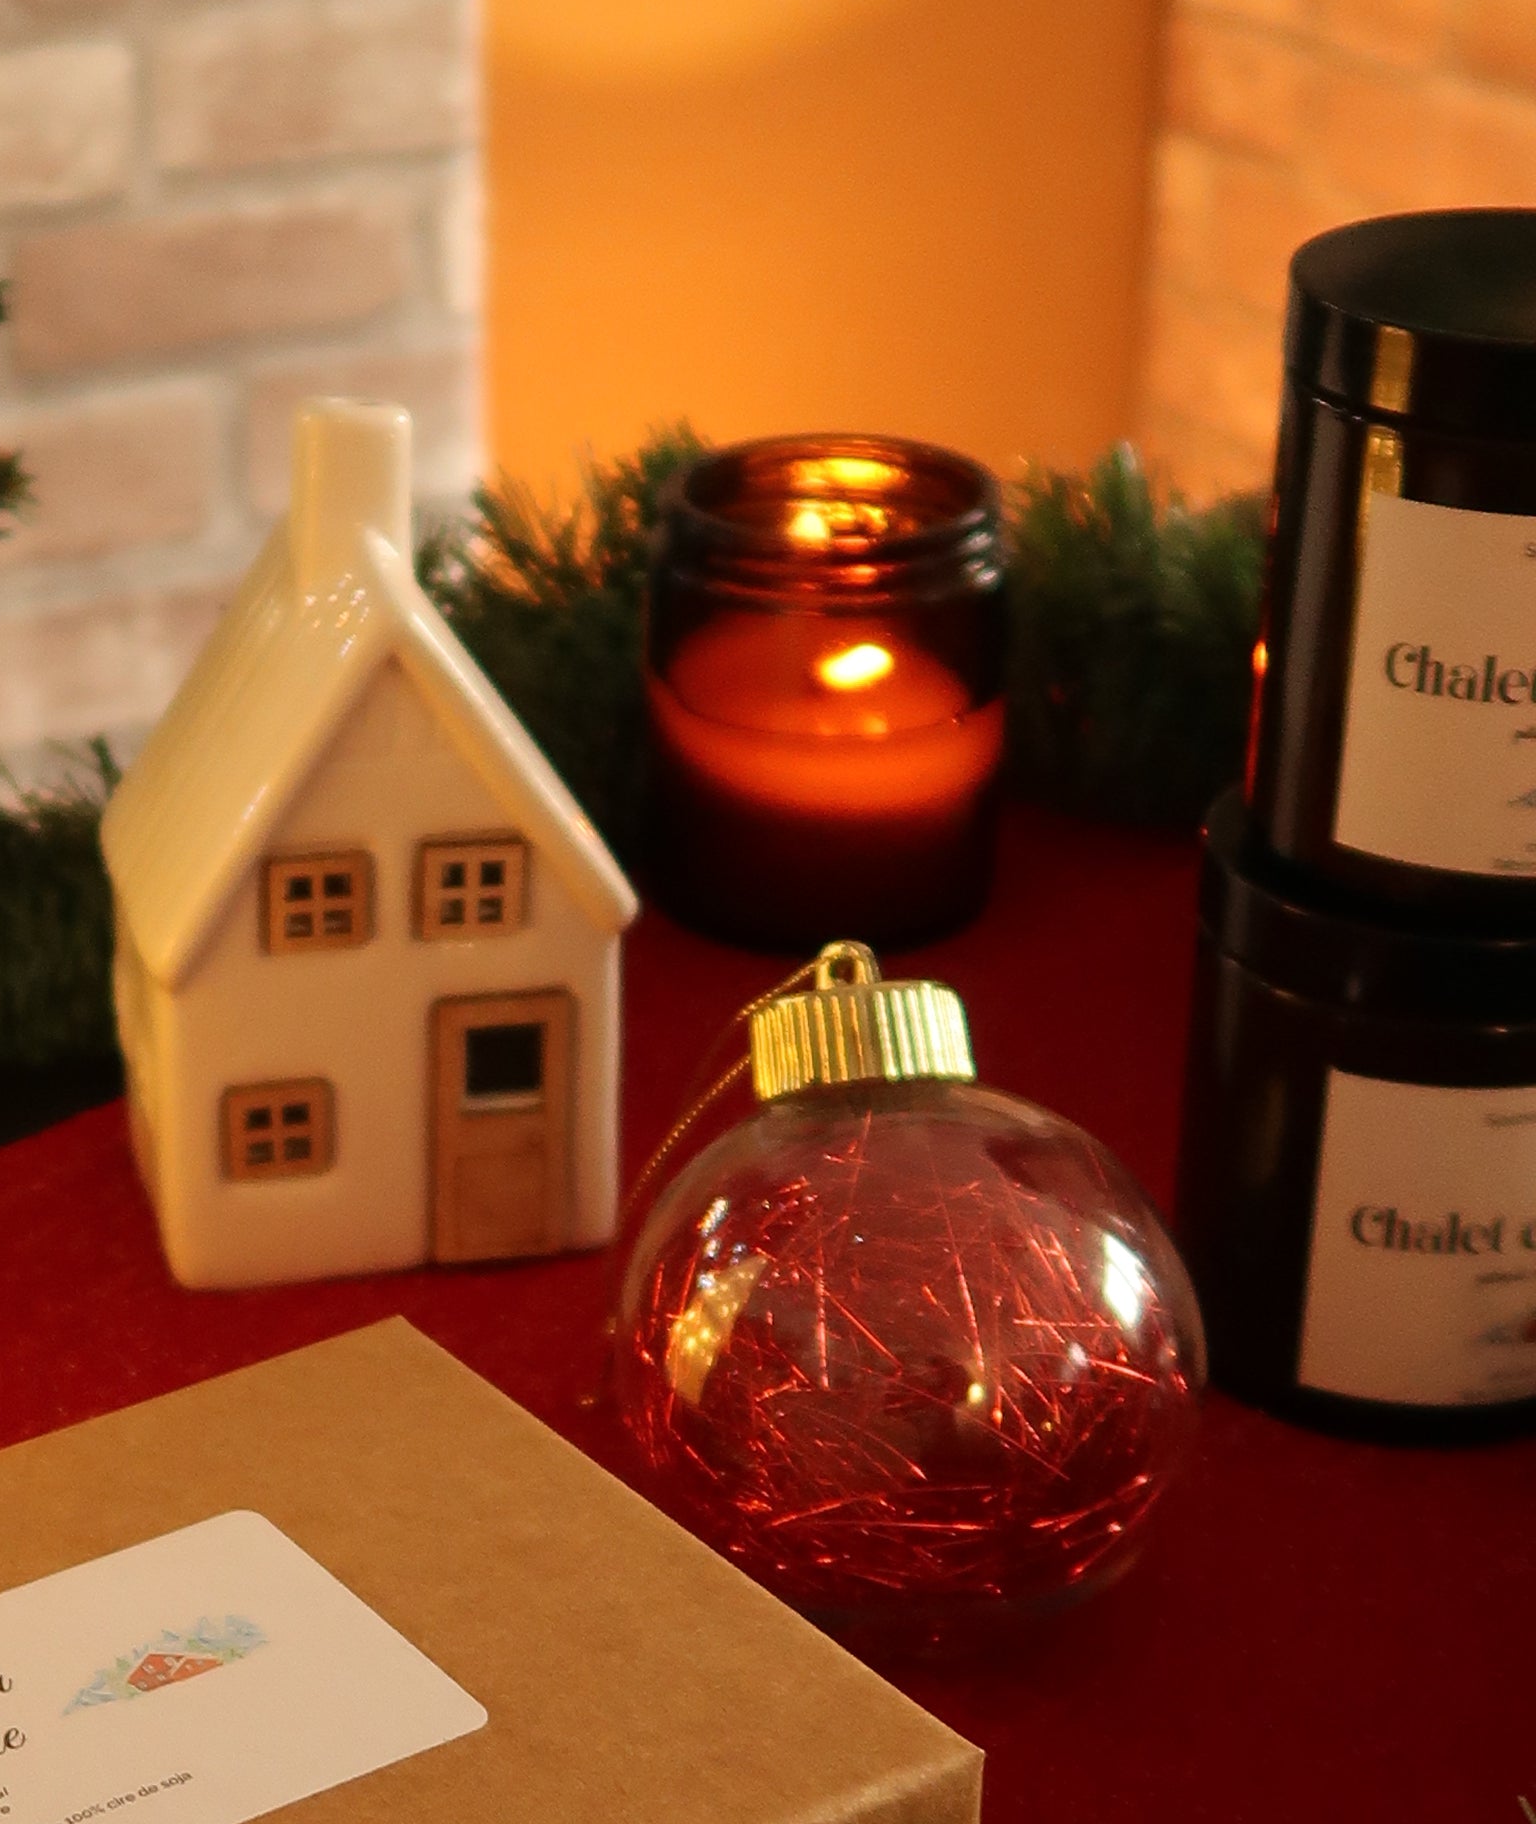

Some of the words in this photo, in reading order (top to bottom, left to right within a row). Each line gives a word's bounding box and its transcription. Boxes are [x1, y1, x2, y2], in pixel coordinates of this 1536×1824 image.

[1350, 1205, 1504, 1256] Chalet
[106, 1792, 137, 1811] cire
[137, 1782, 159, 1798] de
[160, 1771, 194, 1790] soja
